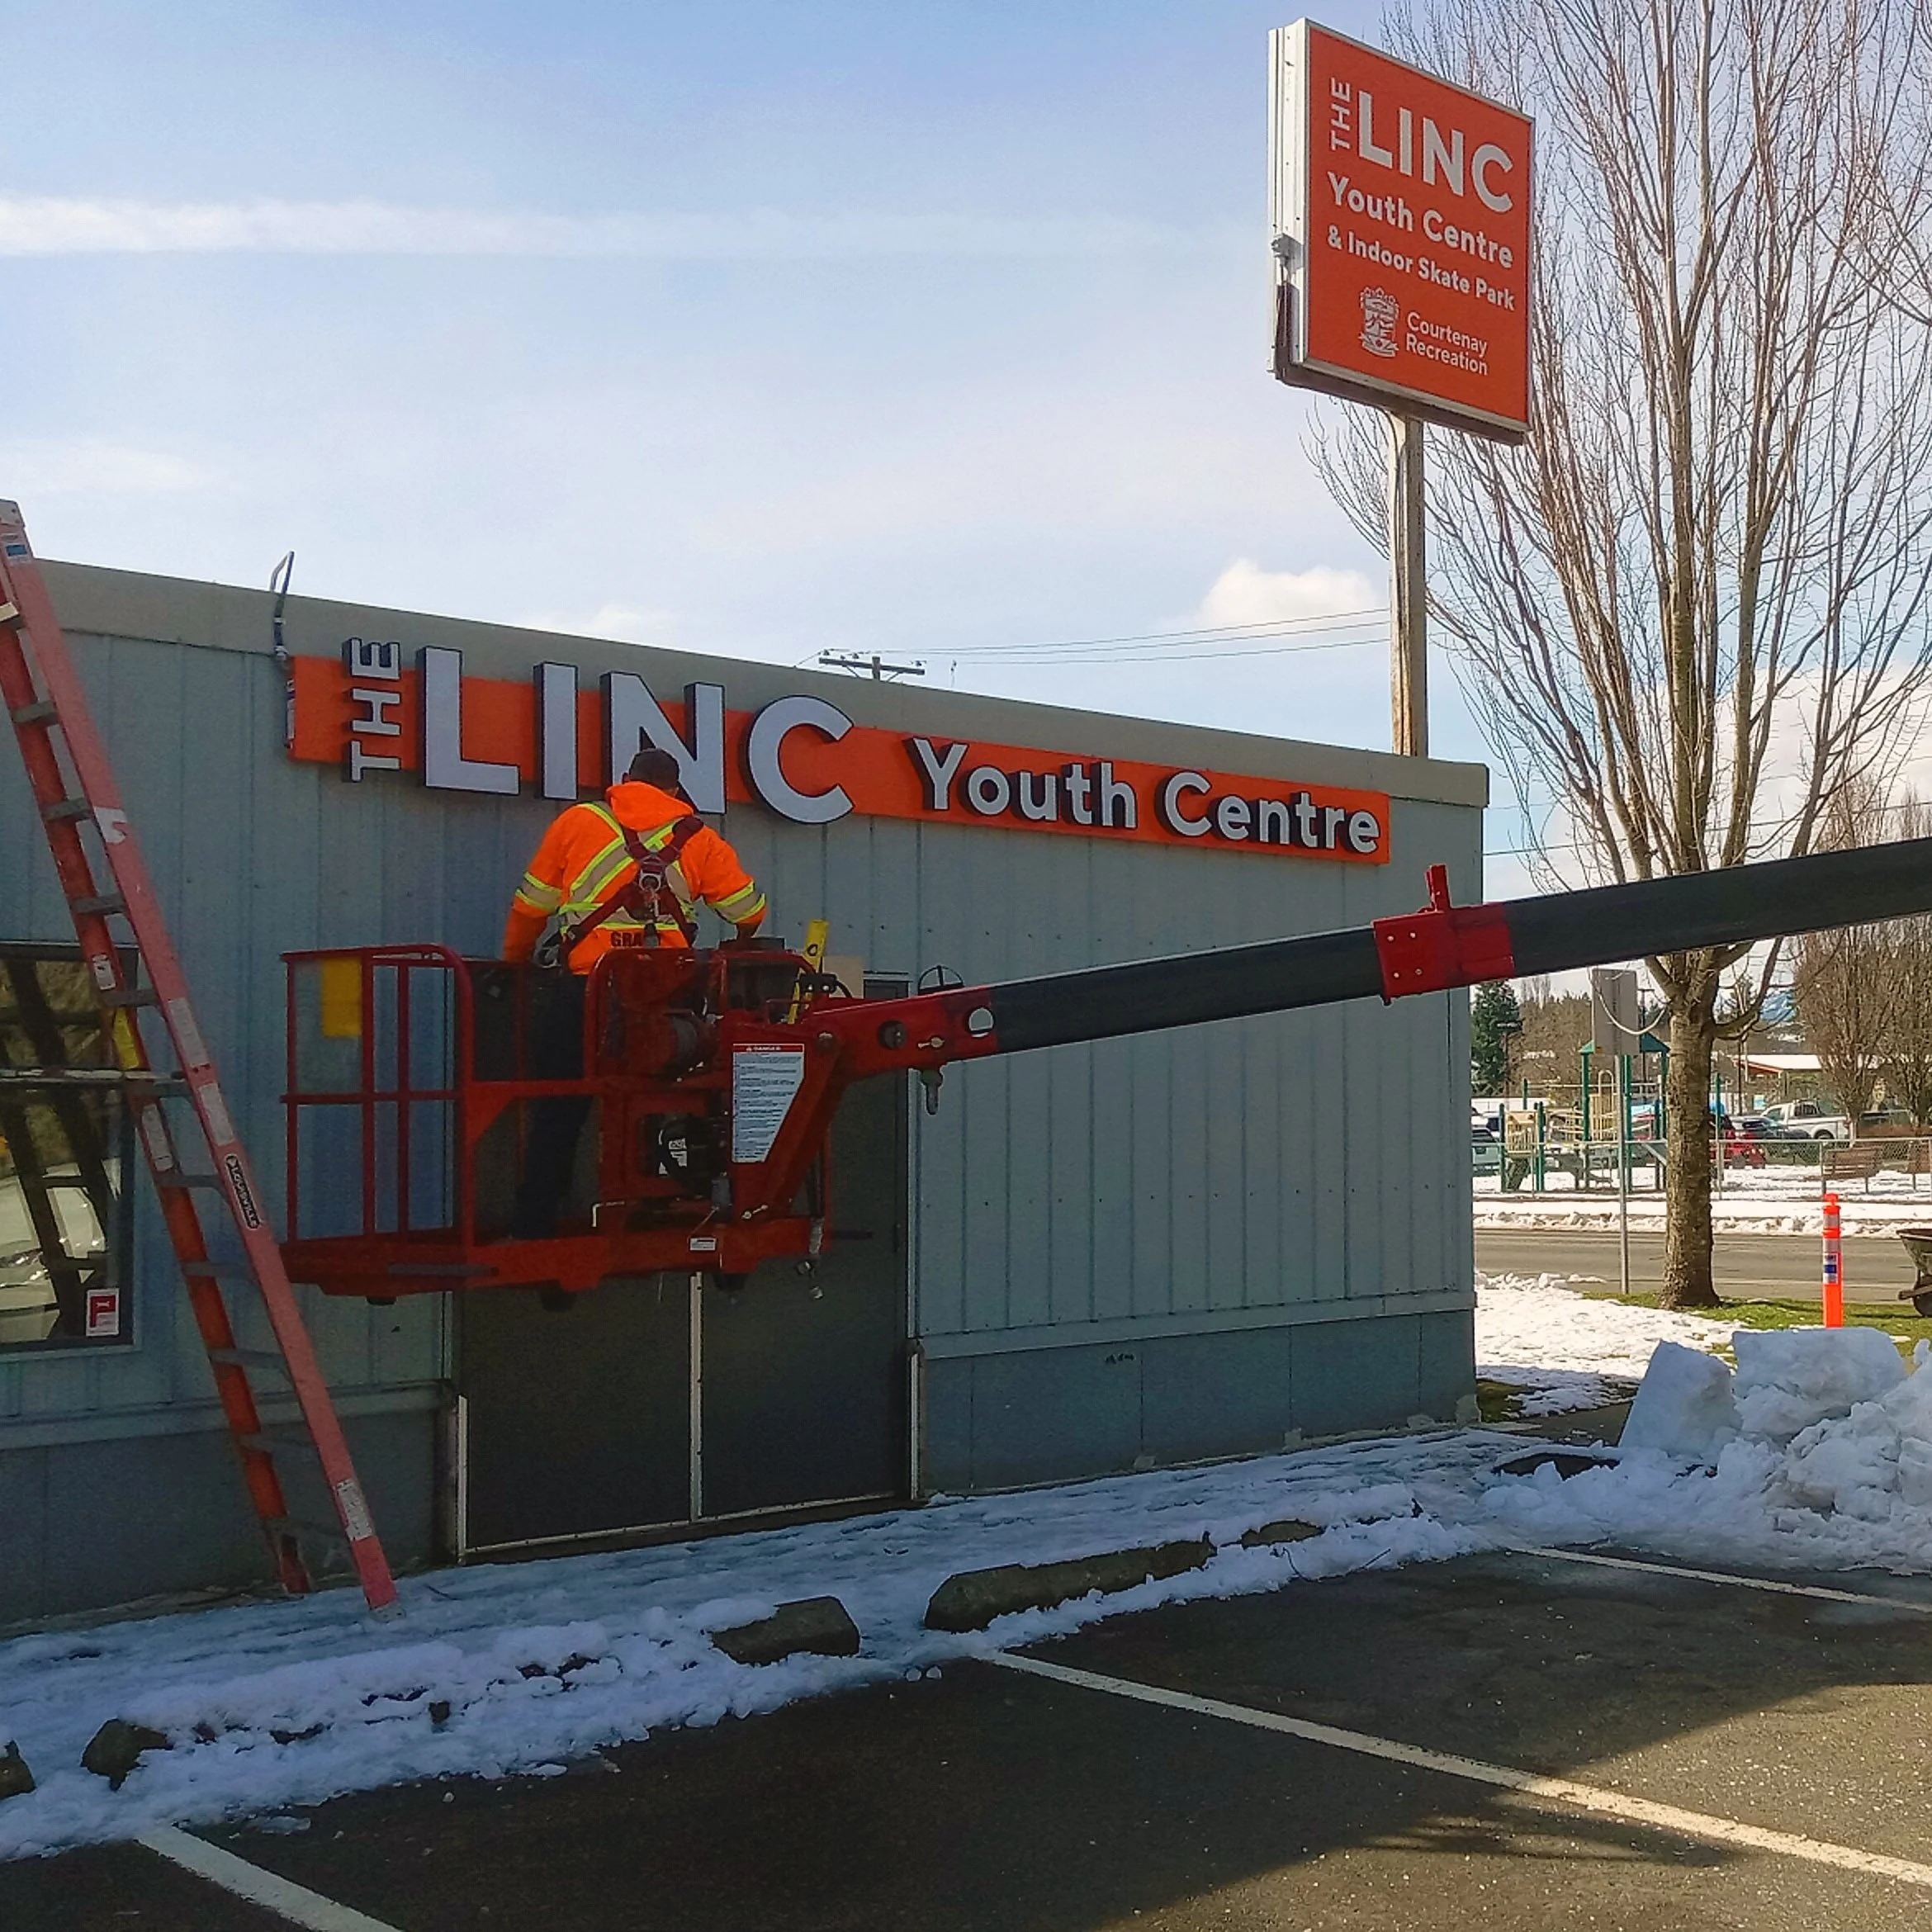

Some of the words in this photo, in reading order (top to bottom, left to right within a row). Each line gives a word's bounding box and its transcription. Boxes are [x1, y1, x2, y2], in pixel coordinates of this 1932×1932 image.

[1331, 77, 1351, 151] THE
[1358, 90, 1513, 213] LINC
[1328, 171, 1413, 231] Youth
[1423, 209, 1513, 268] Centre
[1328, 224, 1342, 249] &
[1348, 230, 1413, 273] Indoor
[1418, 256, 1470, 294] Skate
[1475, 276, 1515, 311] Park
[1406, 333, 1488, 376] Recreation
[1407, 311, 1488, 358] Courtenay
[348, 637, 400, 782] THE
[422, 646, 854, 824] LINC
[911, 737, 1137, 829] Youth
[1163, 771, 1380, 853] Centre
[611, 930, 661, 947] GRA
